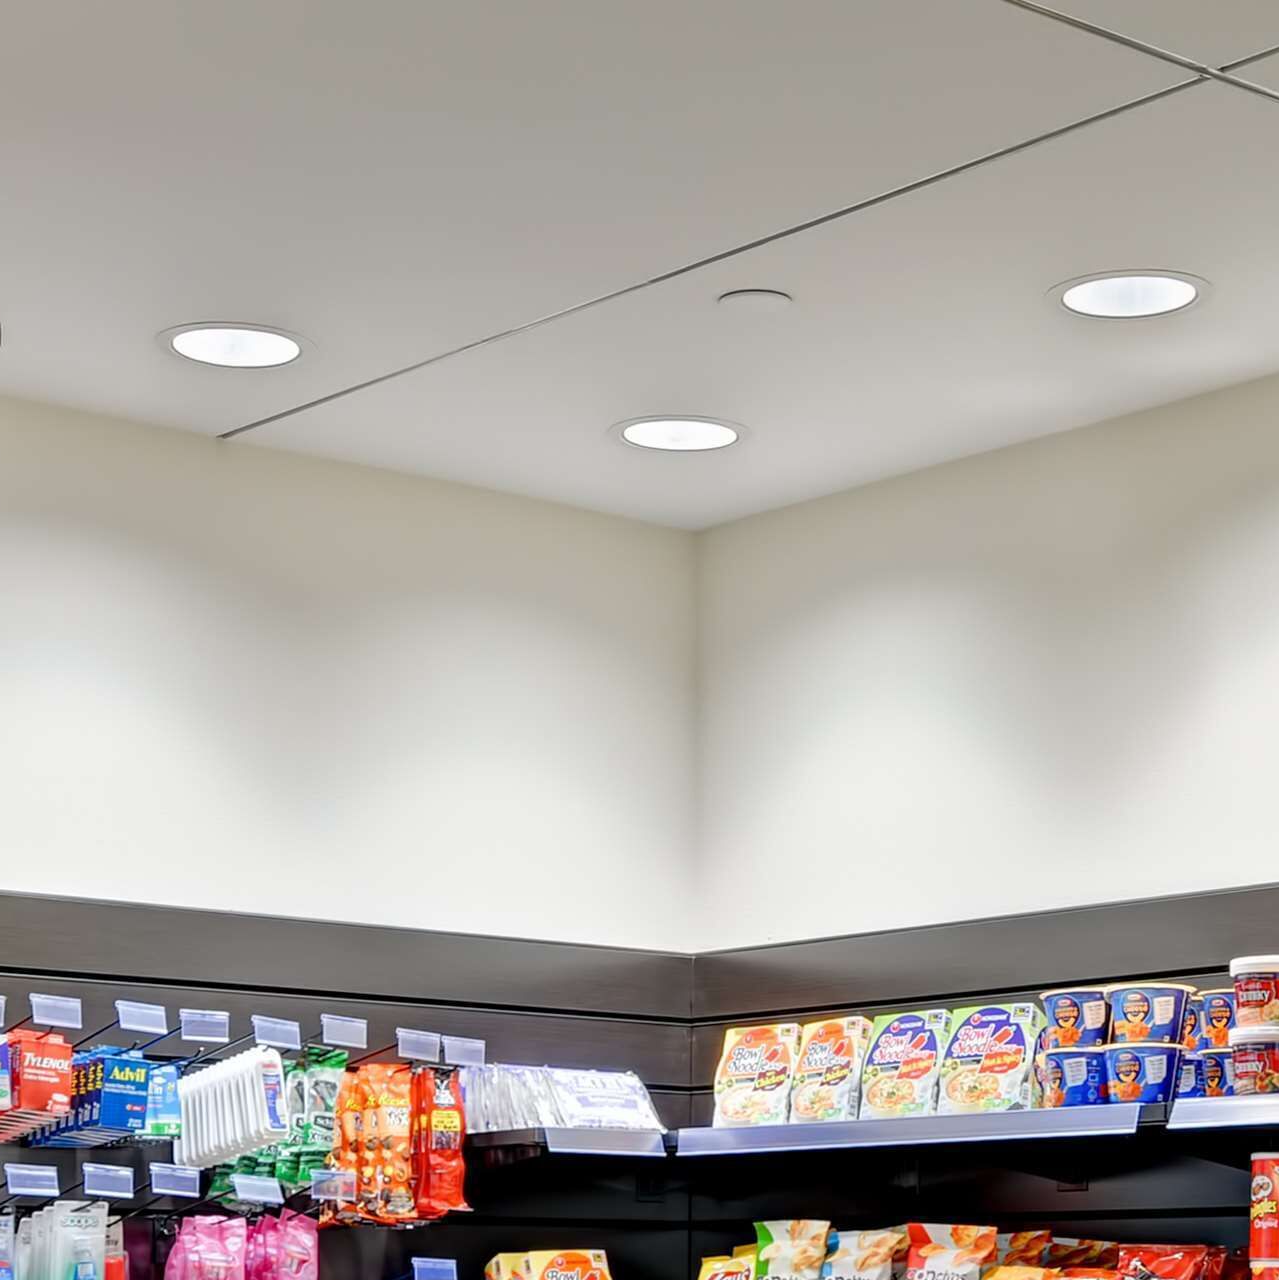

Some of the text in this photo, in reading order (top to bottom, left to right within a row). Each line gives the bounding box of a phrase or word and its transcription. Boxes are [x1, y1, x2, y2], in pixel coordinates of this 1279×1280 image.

[878, 1030, 913, 1048] Bowl
[958, 1023, 995, 1042] Bowl
[734, 1043, 766, 1060] Bowl
[951, 1039, 998, 1057] Noodle
[23, 1051, 71, 1072] TYLENOL
[109, 1065, 148, 1083] Advil
